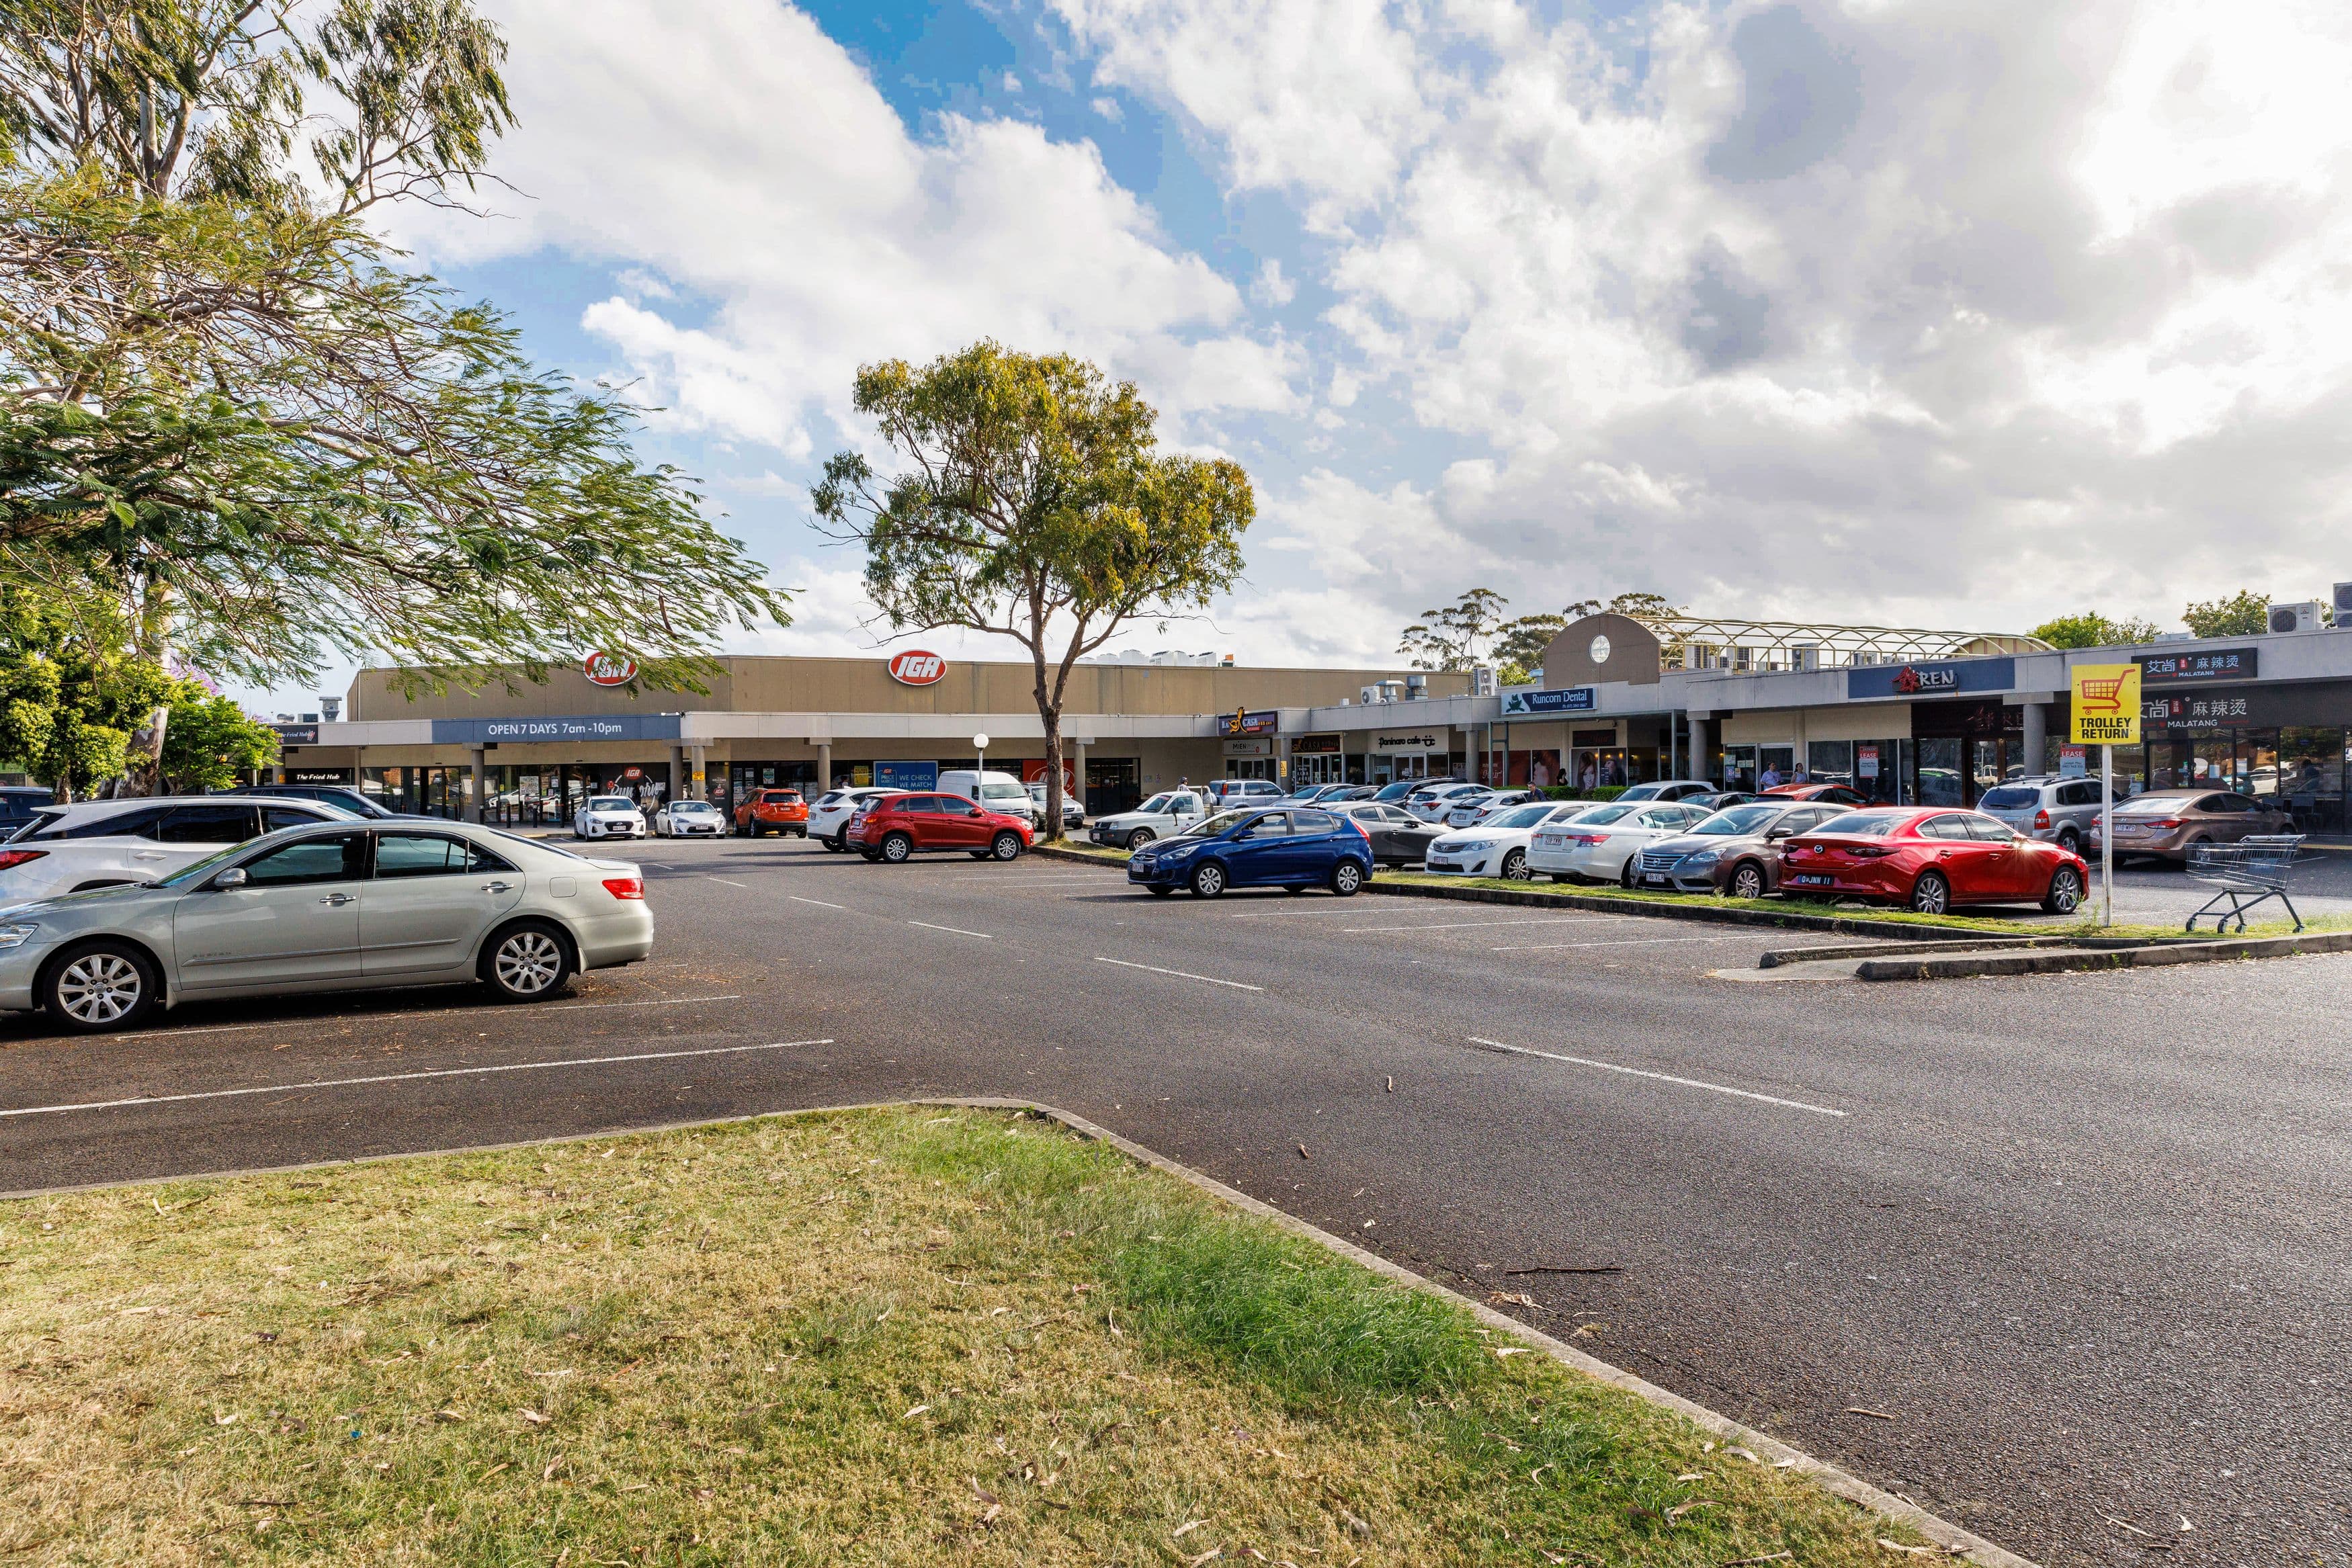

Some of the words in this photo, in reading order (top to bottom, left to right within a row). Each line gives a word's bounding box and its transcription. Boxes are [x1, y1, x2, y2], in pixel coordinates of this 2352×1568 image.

[896, 656, 941, 677] IGA
[2196, 655, 2239, 669] 麻辣烫
[1919, 670, 1954, 685] REN
[1532, 694, 1561, 704] Runcorn
[1563, 690, 1587, 702] Dental
[2193, 699, 2246, 716] 麻辣烫
[1243, 717, 1258, 726] CASA
[2080, 717, 2132, 728] TROLLEY
[2168, 720, 2218, 728] MALATANG
[488, 724, 518, 735] OPEN
[521, 724, 528, 734] 7
[530, 724, 557, 734] DAYS
[562, 724, 585, 733] 7am
[2082, 729, 2128, 738] RETURN
[1304, 742, 1321, 751] CASA
[1378, 737, 1406, 748] Paninaro
